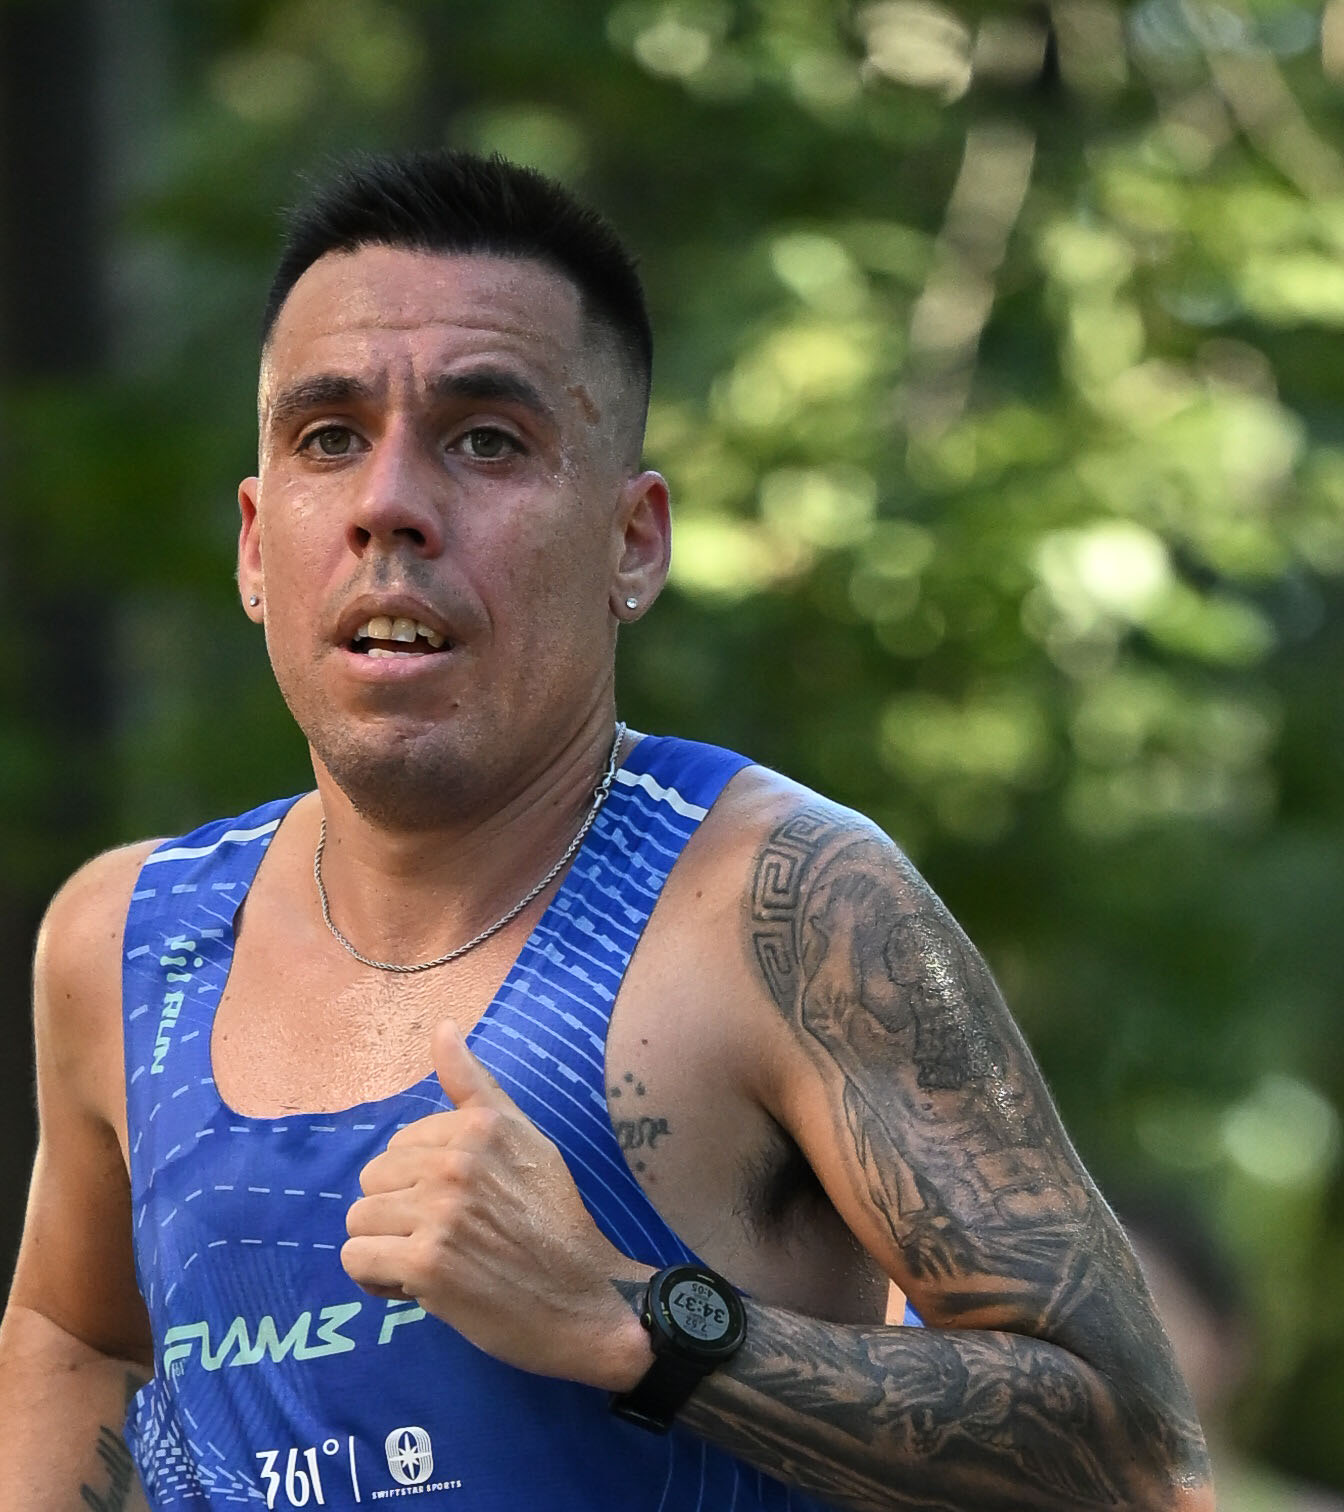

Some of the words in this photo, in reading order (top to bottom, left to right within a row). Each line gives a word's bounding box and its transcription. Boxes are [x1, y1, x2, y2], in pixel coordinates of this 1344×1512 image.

[674, 1292, 725, 1324] 34:37
[255, 1438, 340, 1511] 361°
[371, 1485, 424, 1500] SWIFTSTAR
[426, 1480, 462, 1492] SPORTS
